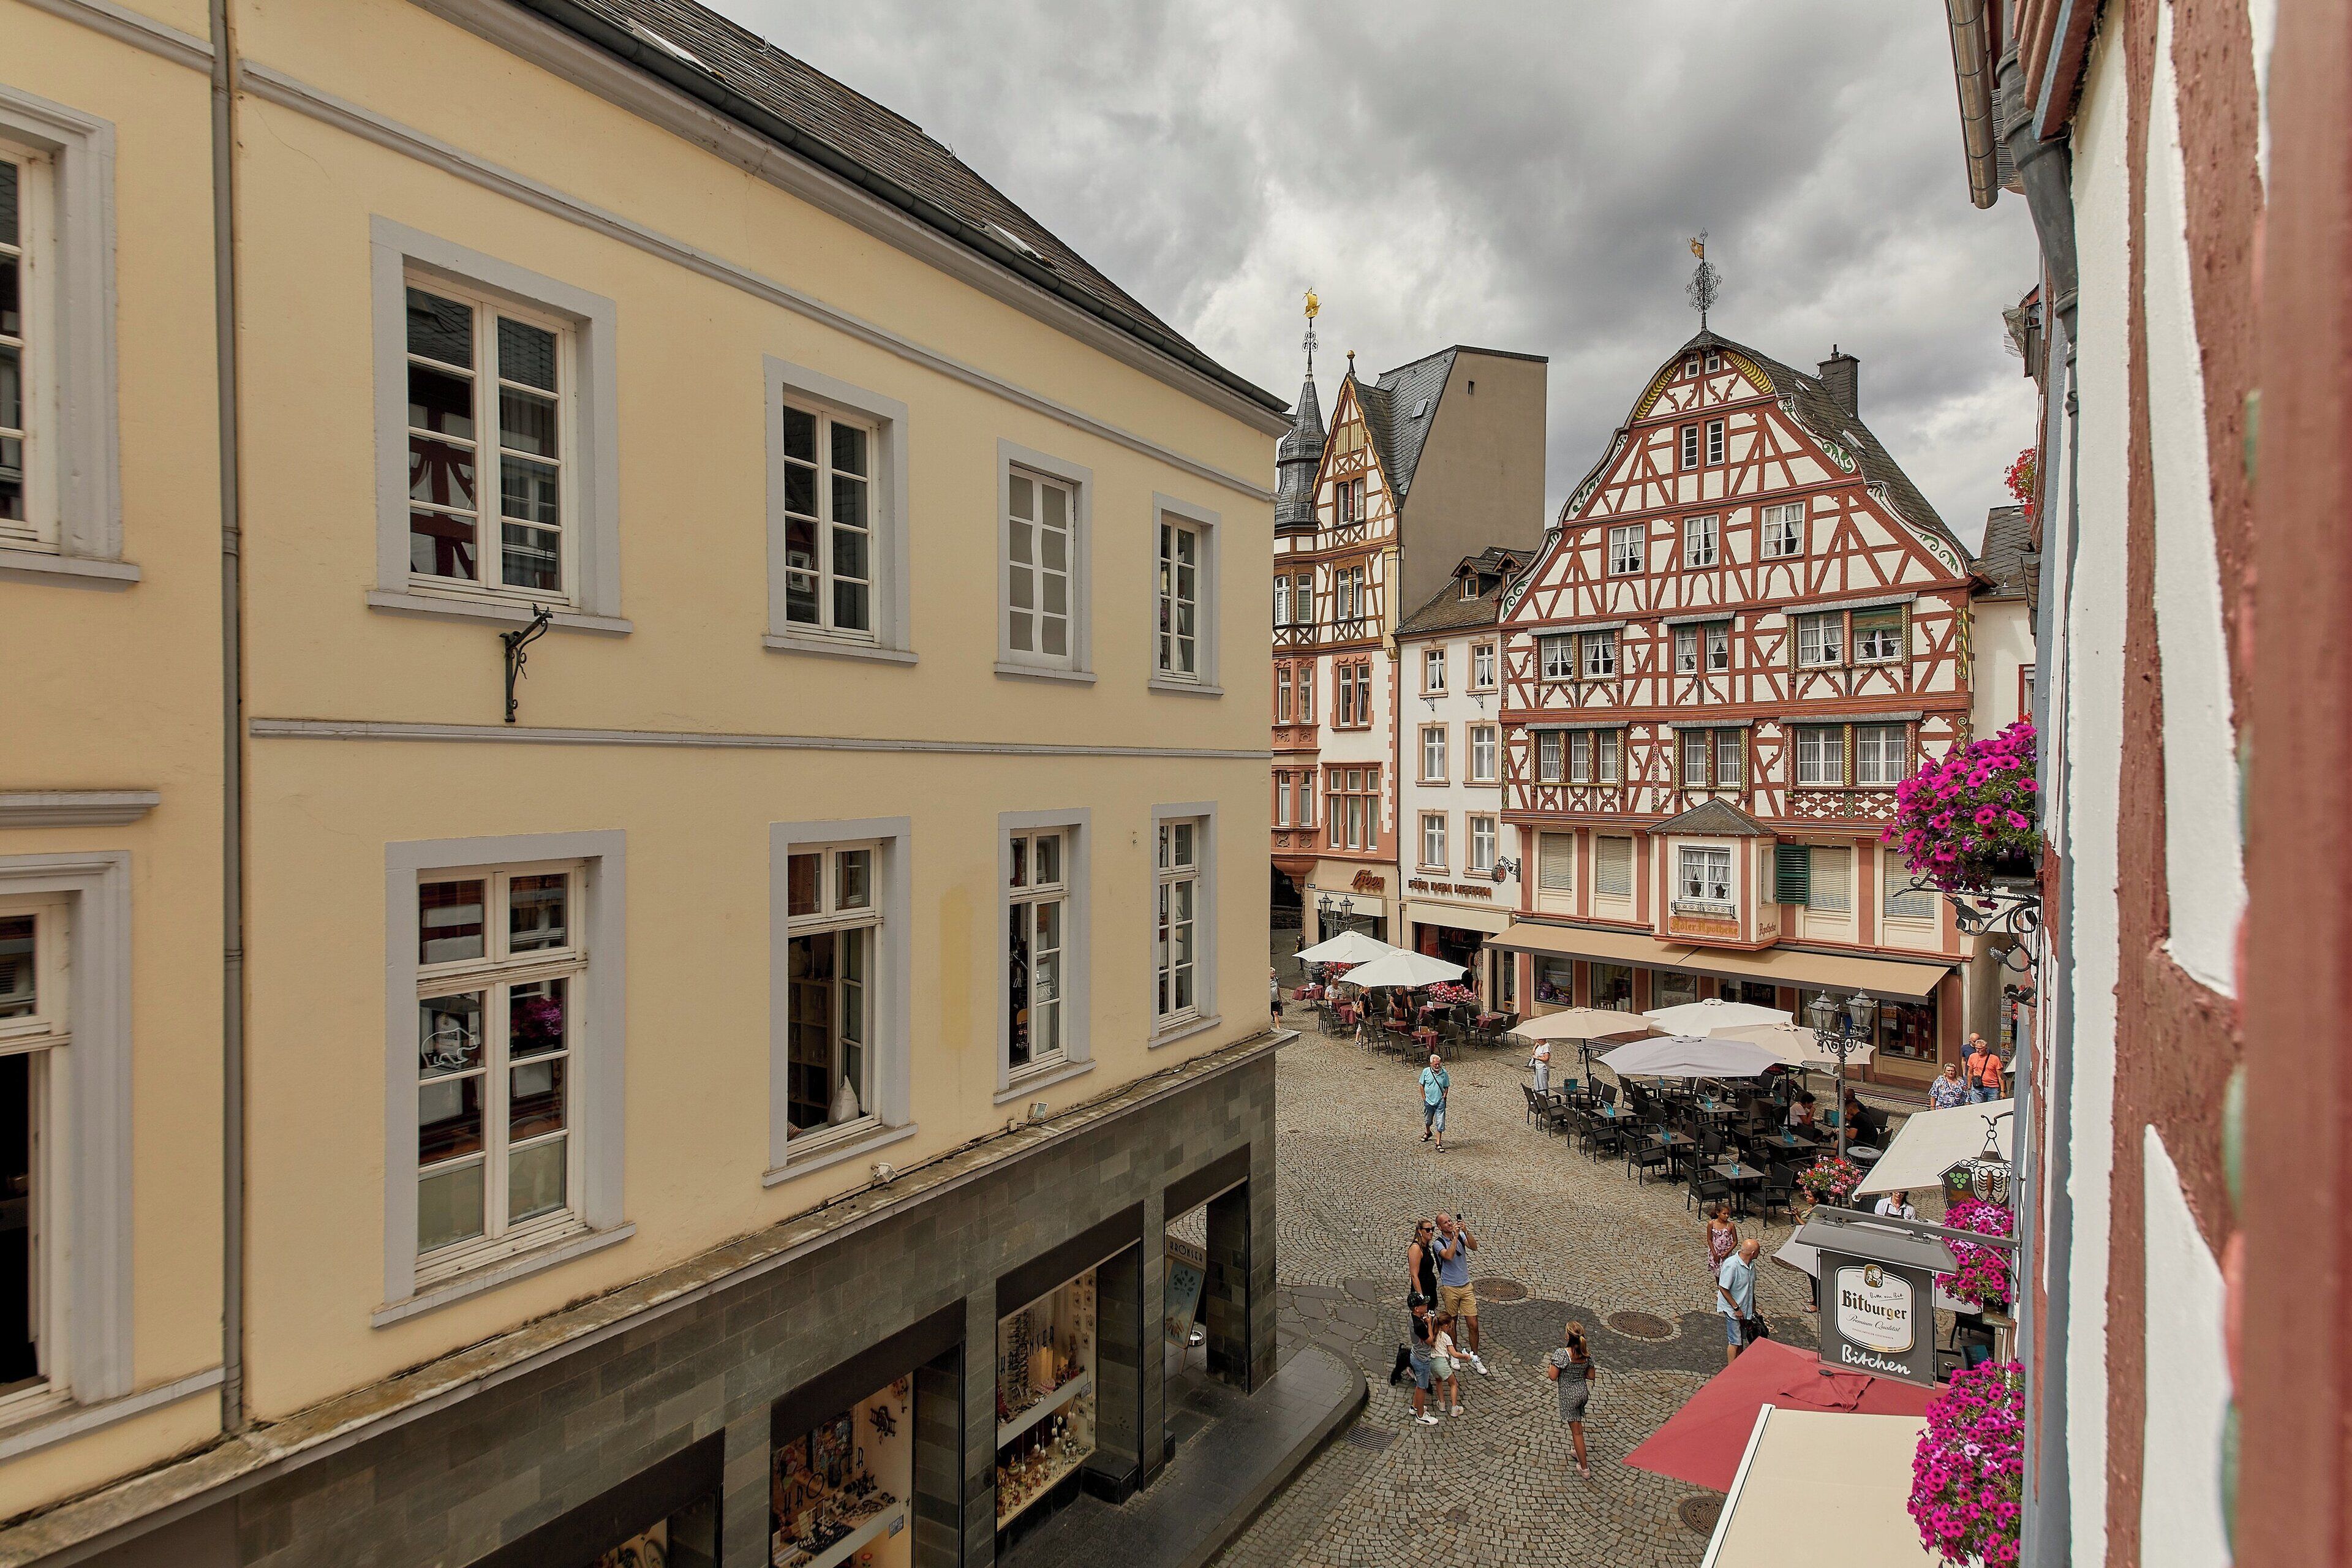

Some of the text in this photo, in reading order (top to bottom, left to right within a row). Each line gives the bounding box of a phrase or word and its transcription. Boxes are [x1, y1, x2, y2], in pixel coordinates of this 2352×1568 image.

[1408, 877, 1492, 897] FÜR DEN HERRN
[1758, 922, 1776, 937] Apotheke
[1841, 1289, 1907, 1320] Bitburger
[1845, 1314, 1873, 1327] Premium
[1841, 1344, 1911, 1375] Bitchen
